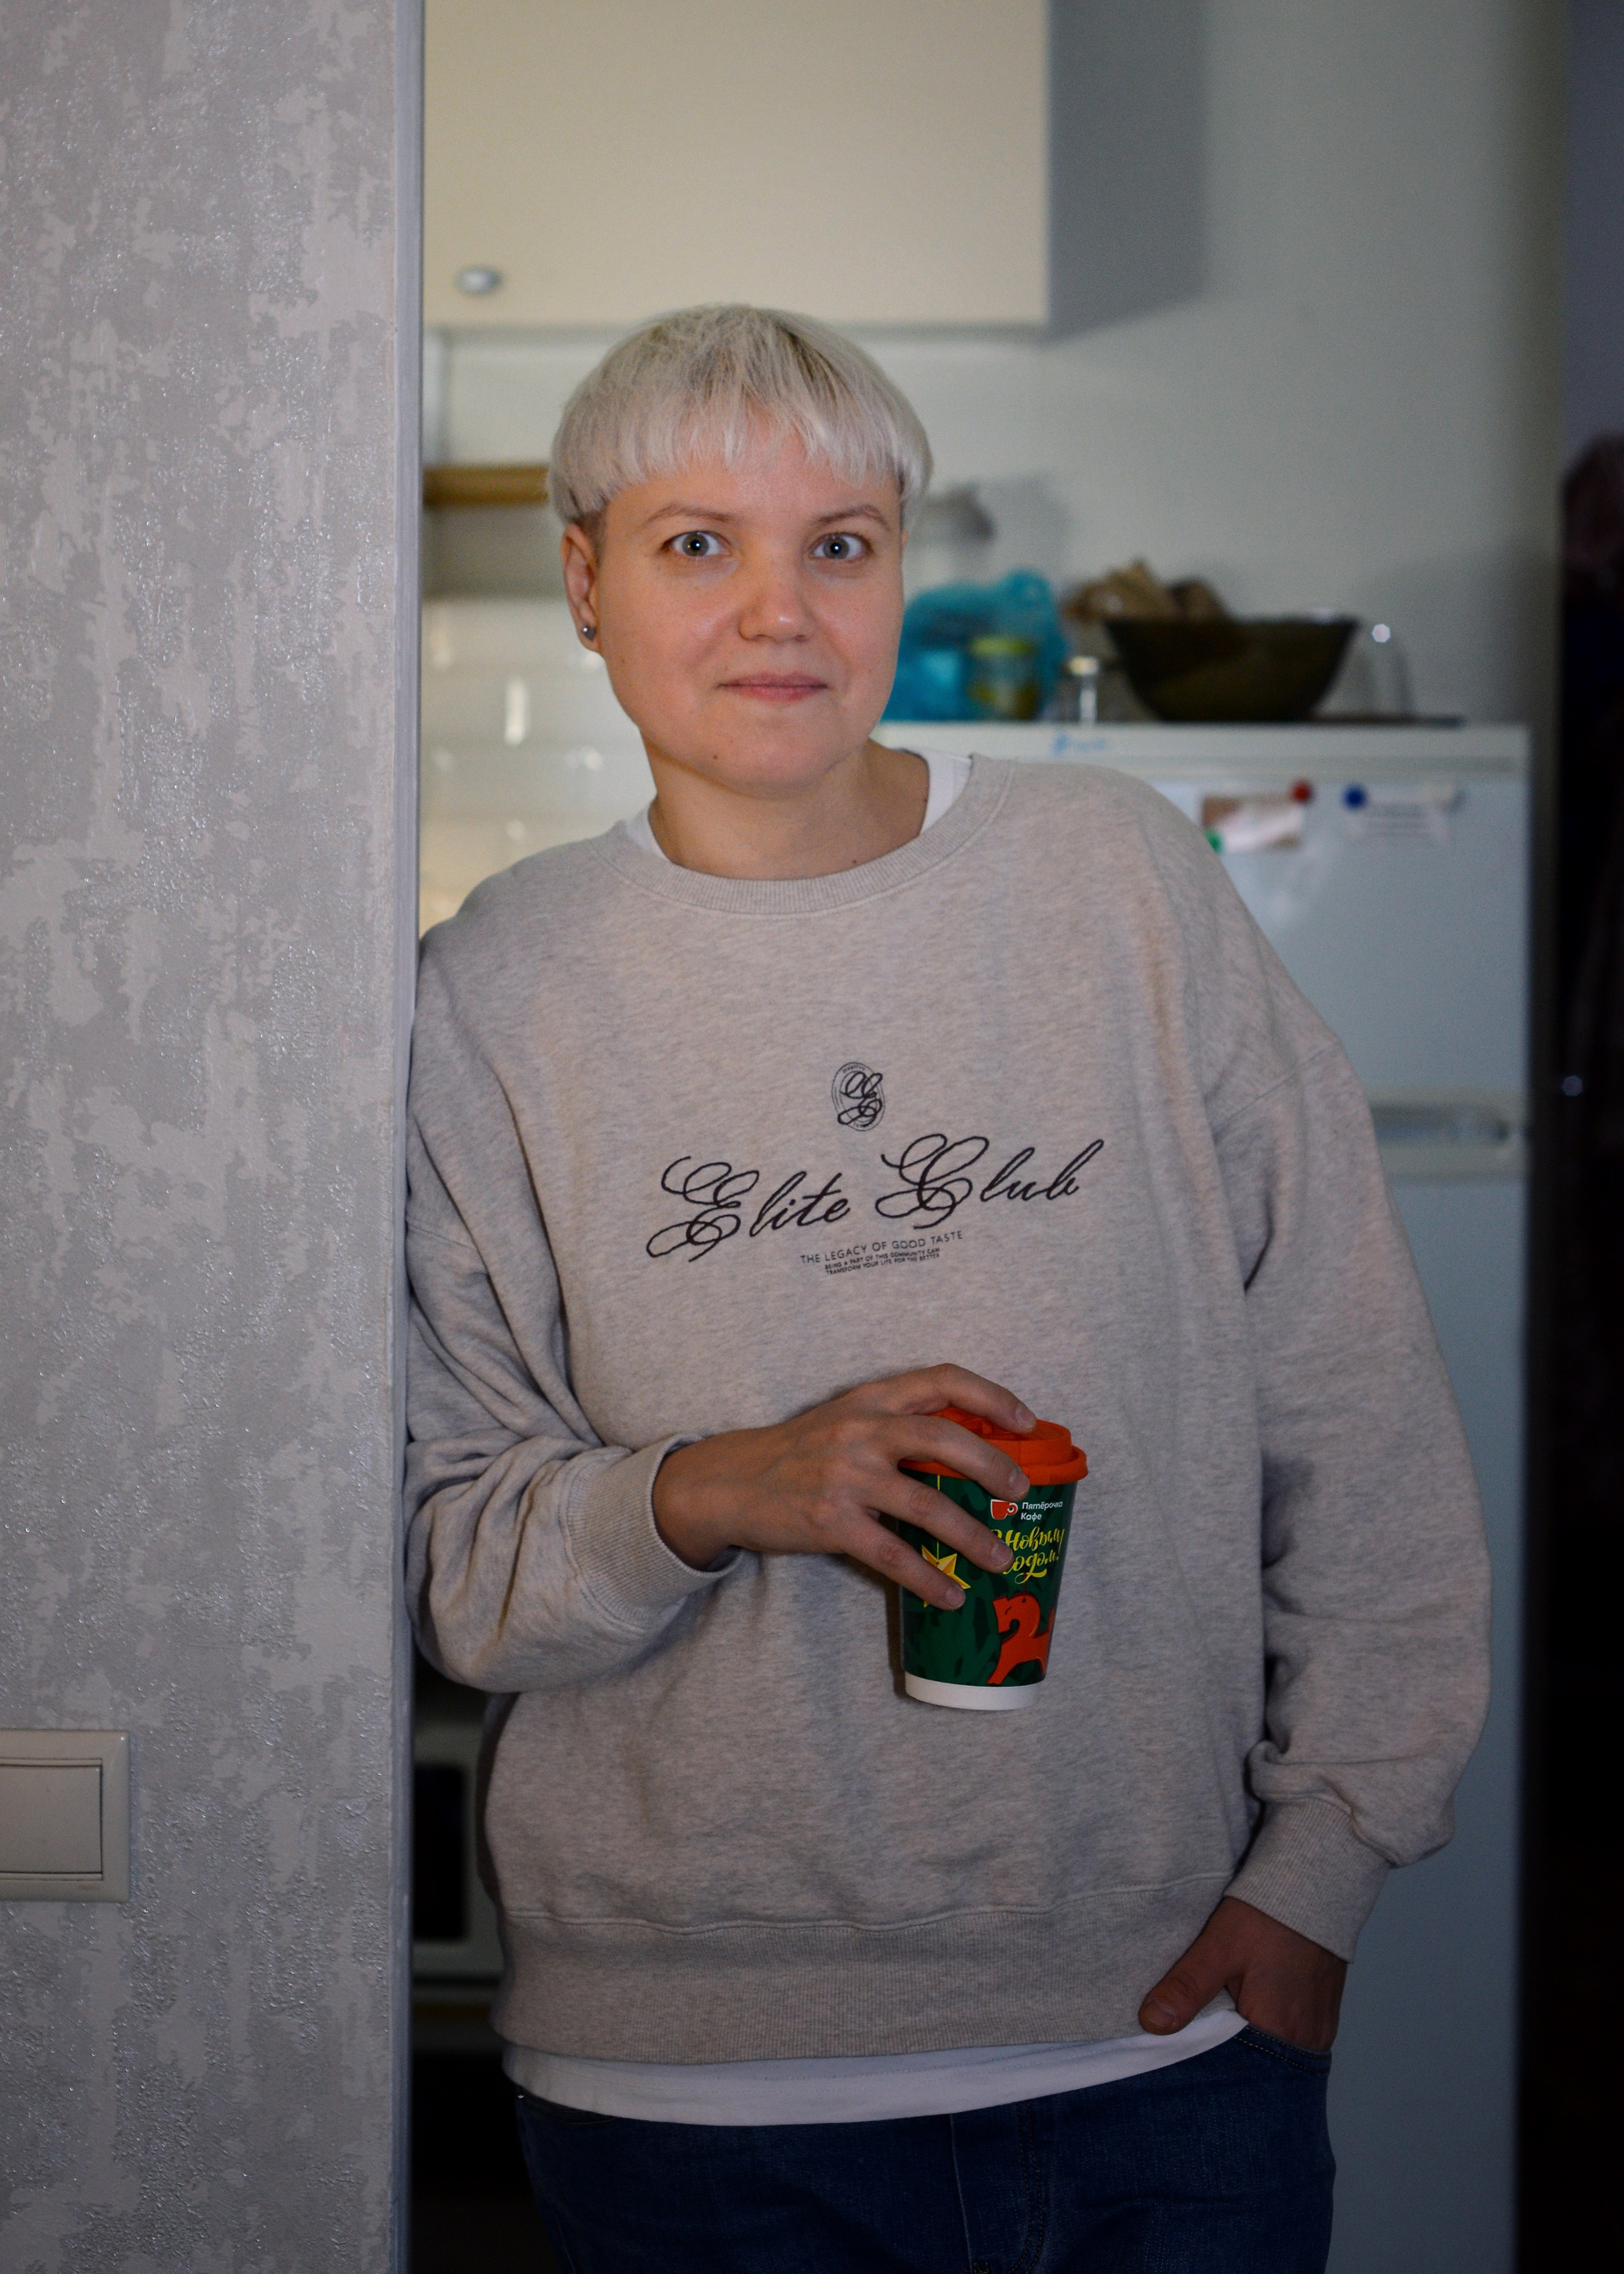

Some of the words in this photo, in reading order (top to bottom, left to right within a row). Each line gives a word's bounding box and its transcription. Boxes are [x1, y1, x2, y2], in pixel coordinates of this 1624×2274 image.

[646, 1155, 851, 1262] Elite
[800, 1254, 821, 1263] THE
[825, 1245, 867, 1261] LEGACY
[872, 1241, 887, 1252] OF
[892, 1239, 926, 1249] GOOD
[931, 1230, 963, 1244] TASTE
[1021, 1512, 1042, 1522] Кафе
